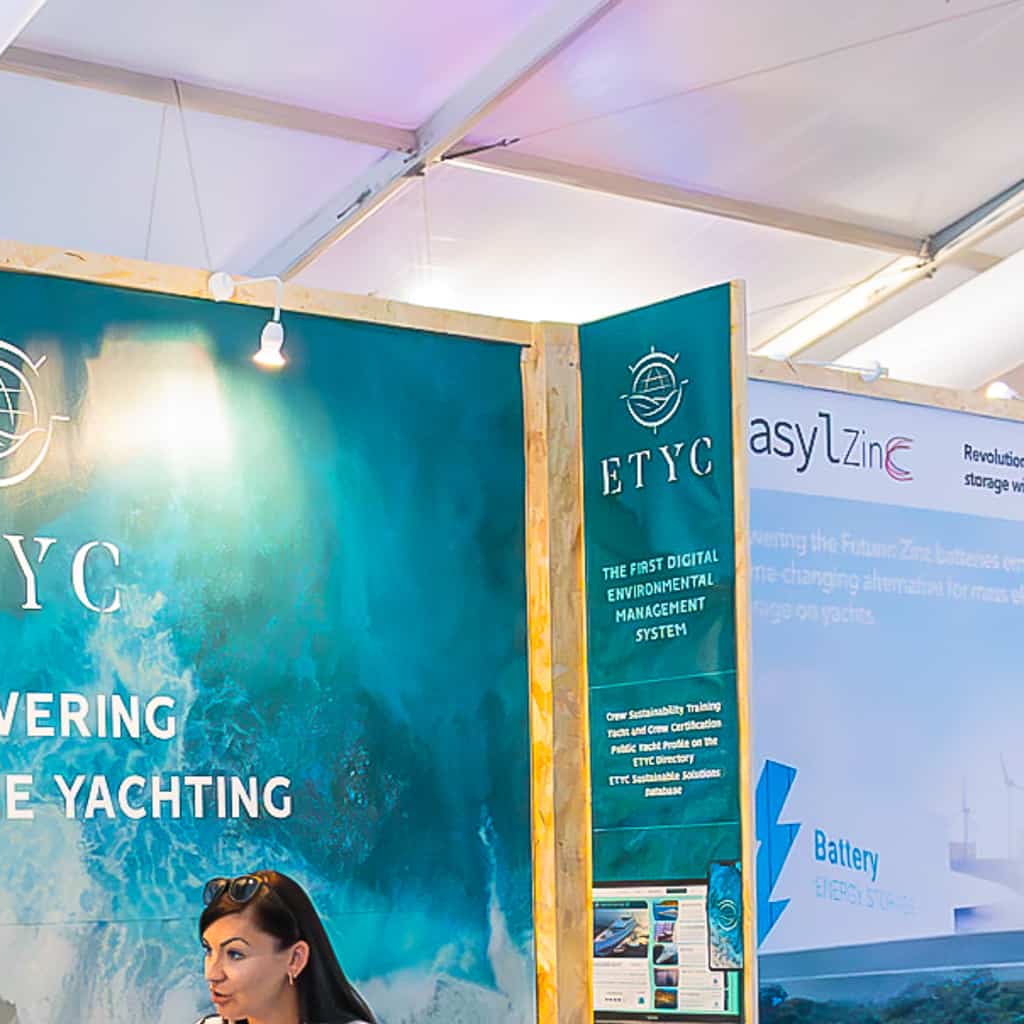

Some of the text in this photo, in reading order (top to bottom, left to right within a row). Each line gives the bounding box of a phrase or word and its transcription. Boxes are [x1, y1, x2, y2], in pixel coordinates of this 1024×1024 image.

[601, 437, 713, 496] ETYC
[964, 472, 1010, 495] storage
[602, 548, 719, 581] THE FIRST DIGITAL
[607, 572, 714, 602] ENVIRONMENTAL
[616, 596, 706, 623] MANAGEMENT
[635, 622, 687, 642] SYSTEM
[55, 775, 292, 820] YACHTING
[814, 828, 879, 882] Battery
